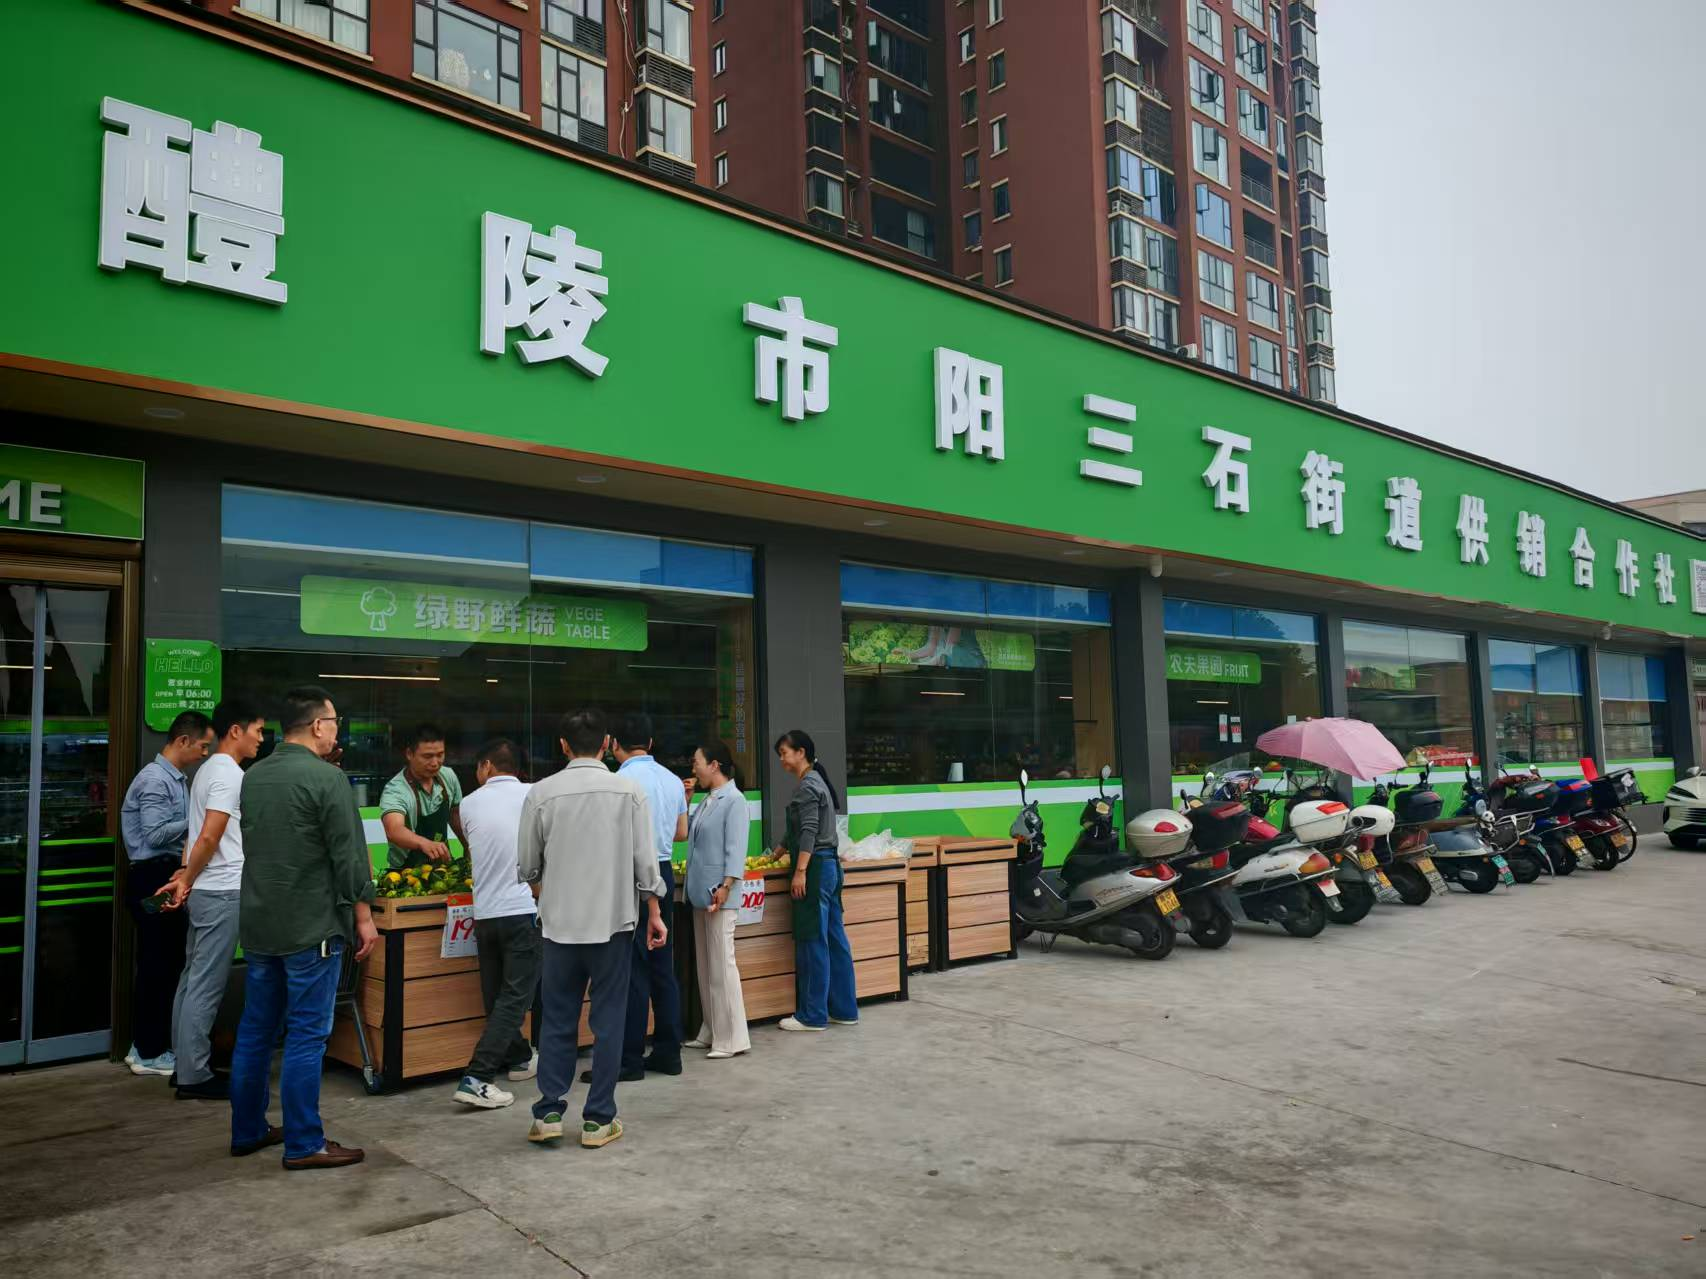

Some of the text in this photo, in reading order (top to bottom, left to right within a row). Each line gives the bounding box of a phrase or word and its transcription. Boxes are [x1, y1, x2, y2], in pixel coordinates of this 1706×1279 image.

[98, 95, 1677, 604] 醴陵市阳三石街道供销合作社
[414, 593, 556, 635] 绿野鲜蔬
[565, 606, 605, 621] VEGE
[564, 623, 611, 640] TABLE
[154, 657, 214, 673] HELLO
[1223, 663, 1250, 678] FRUIT
[167, 678, 201, 688] 营业时间
[185, 689, 212, 699] 06:00
[188, 701, 215, 710] 21:30
